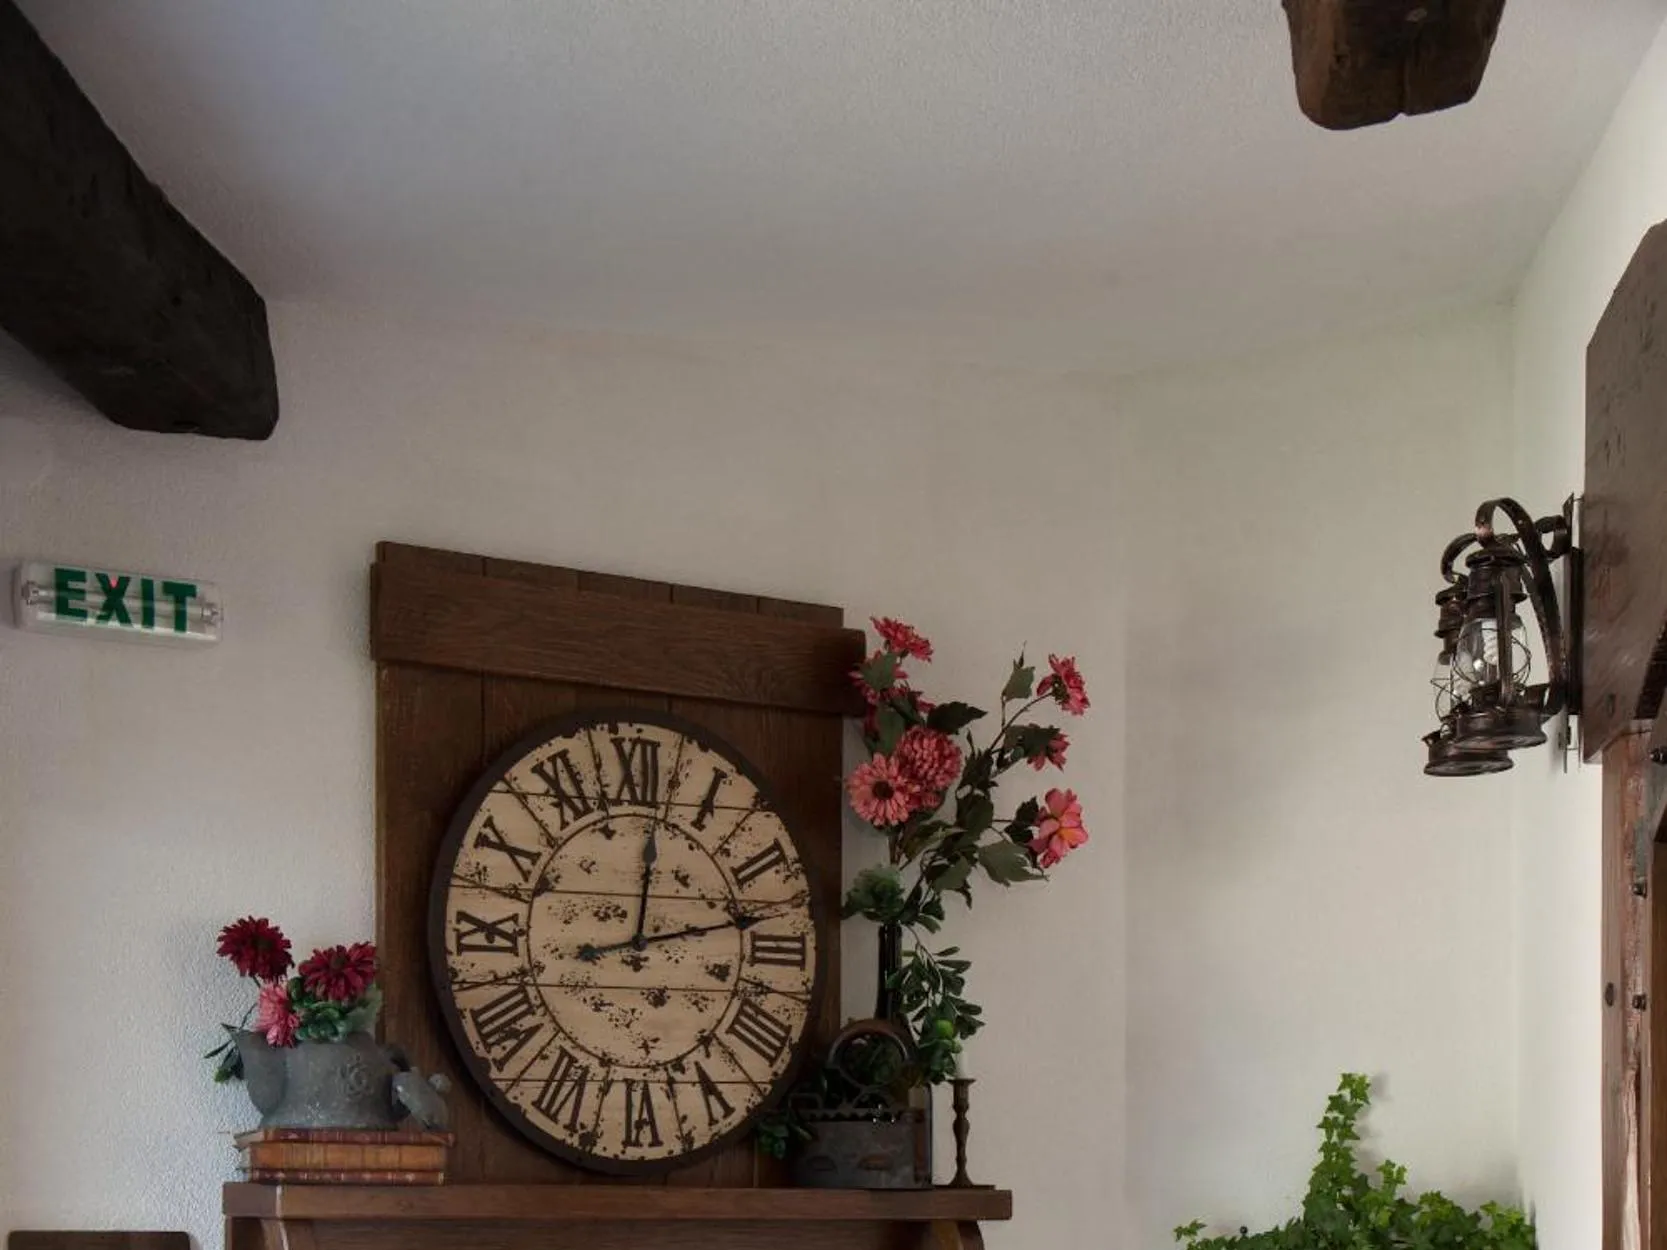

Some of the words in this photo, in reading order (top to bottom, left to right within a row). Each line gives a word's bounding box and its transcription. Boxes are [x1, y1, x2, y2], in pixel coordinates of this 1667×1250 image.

[54, 568, 197, 633] EXIT
[531, 749, 594, 831] XI
[611, 737, 660, 808] XII
[690, 767, 728, 831] I
[474, 816, 541, 882] X
[729, 838, 788, 891] II
[455, 910, 520, 957] IX
[748, 931, 806, 970] III
[470, 987, 545, 1072] VIII
[726, 1000, 792, 1067] IIII
[531, 1047, 589, 1134] VII
[622, 1079, 664, 1148] VI
[695, 1060, 735, 1126] V
